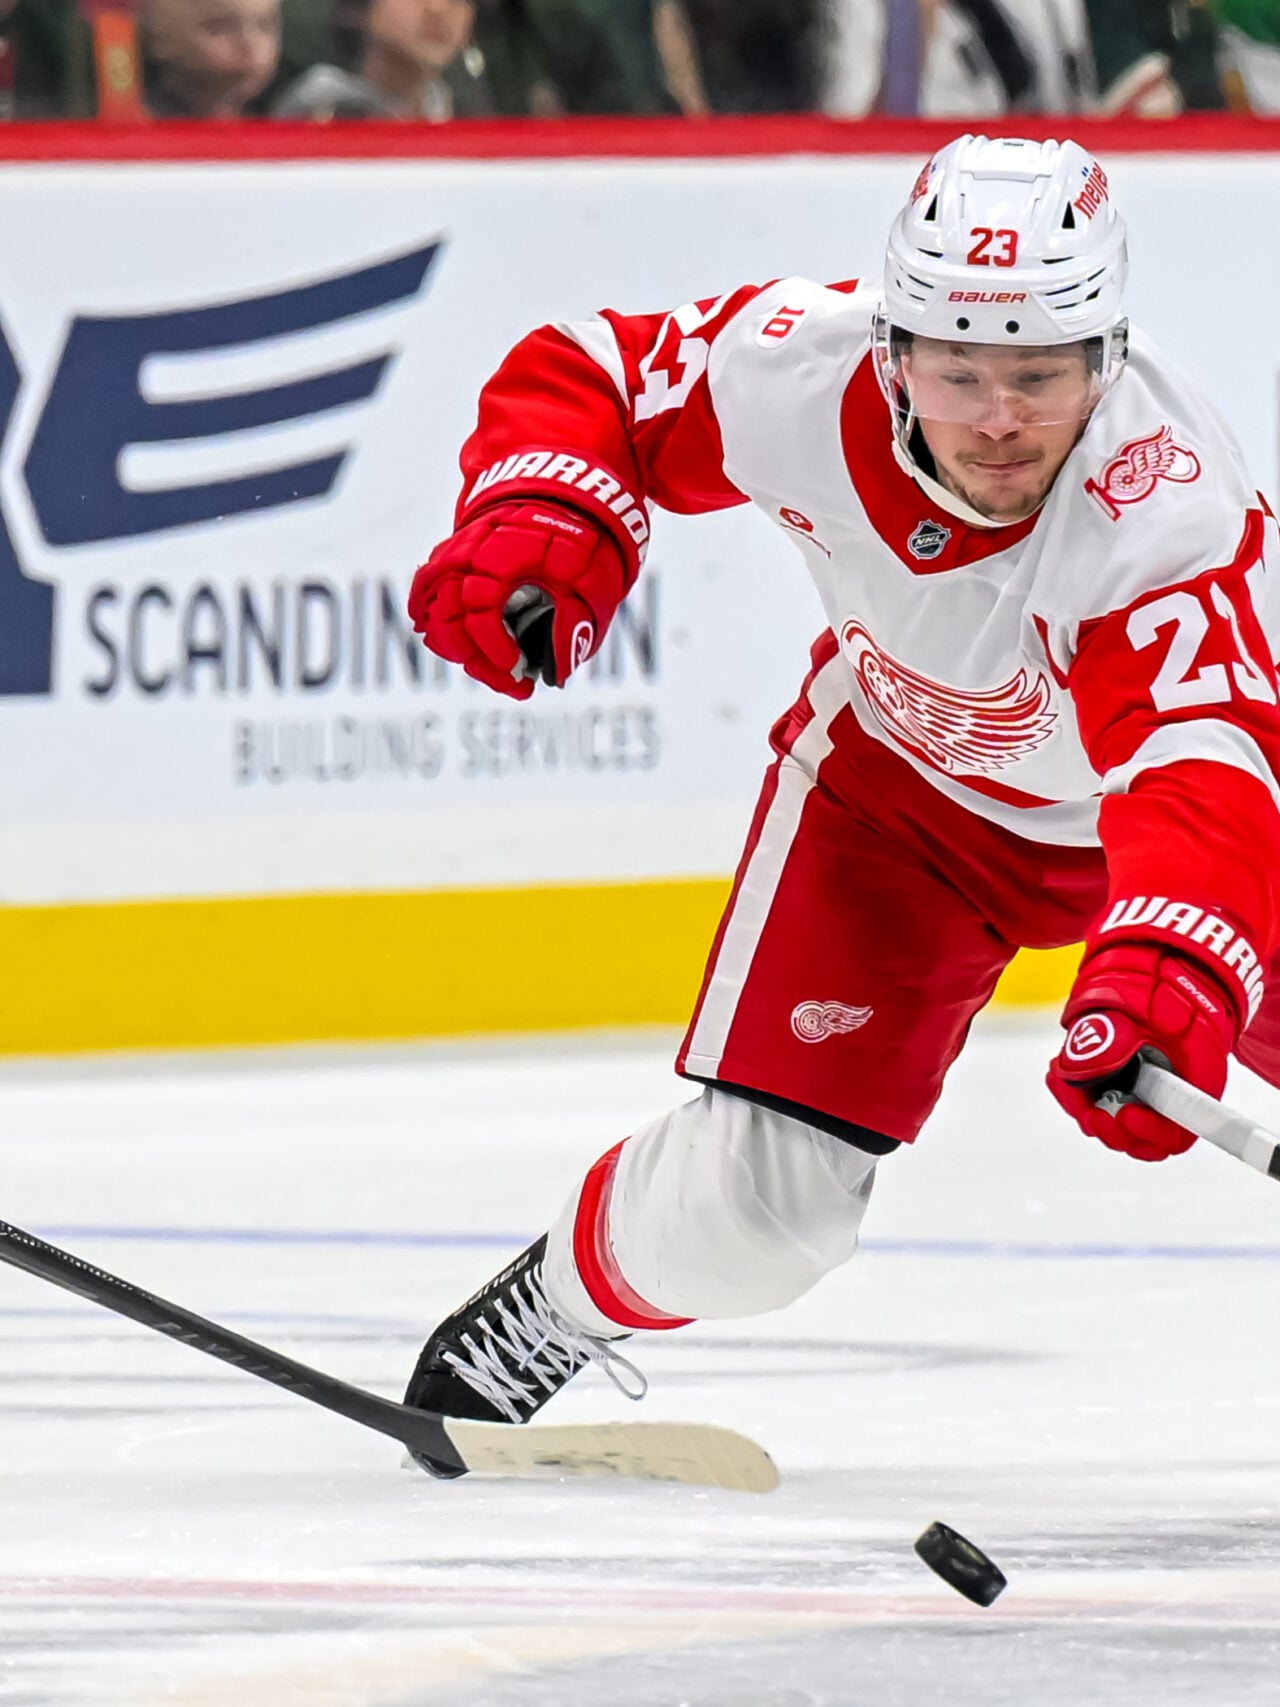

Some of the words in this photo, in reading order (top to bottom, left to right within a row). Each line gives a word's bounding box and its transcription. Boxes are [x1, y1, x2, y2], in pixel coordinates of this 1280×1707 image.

[966, 227, 1019, 268] 23
[913, 534, 943, 549] NHL
[232, 713, 444, 784] BUILDING
[458, 706, 660, 777] SERVICES
[1176, 975, 1219, 1014] COVERT
